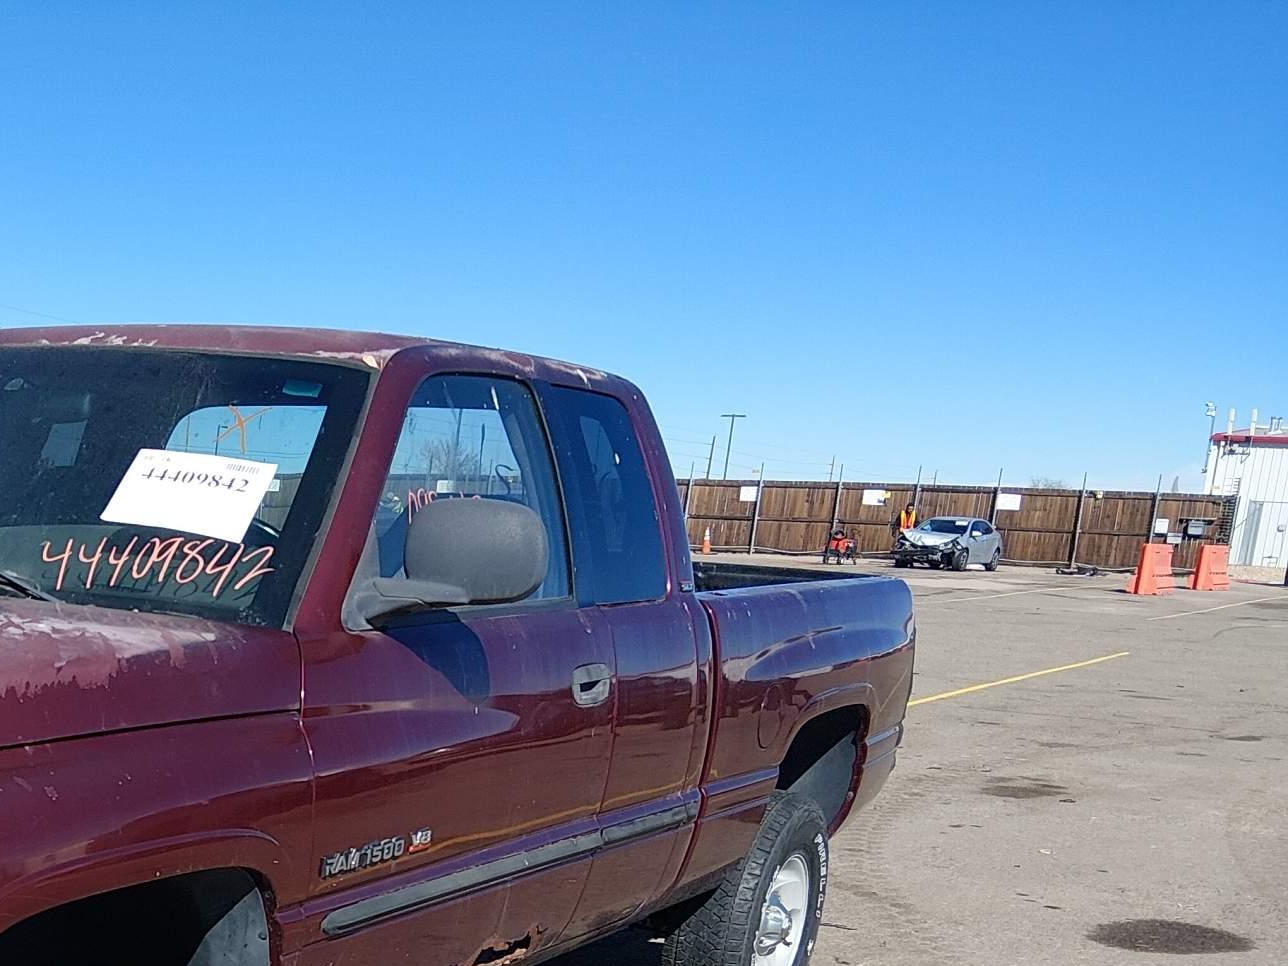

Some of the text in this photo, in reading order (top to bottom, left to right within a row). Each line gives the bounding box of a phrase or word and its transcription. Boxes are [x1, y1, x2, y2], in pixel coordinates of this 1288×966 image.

[141, 467, 249, 493] 44409842
[40, 535, 276, 598] 44409842
[321, 850, 361, 879] RAM
[363, 836, 405, 868] 1500
